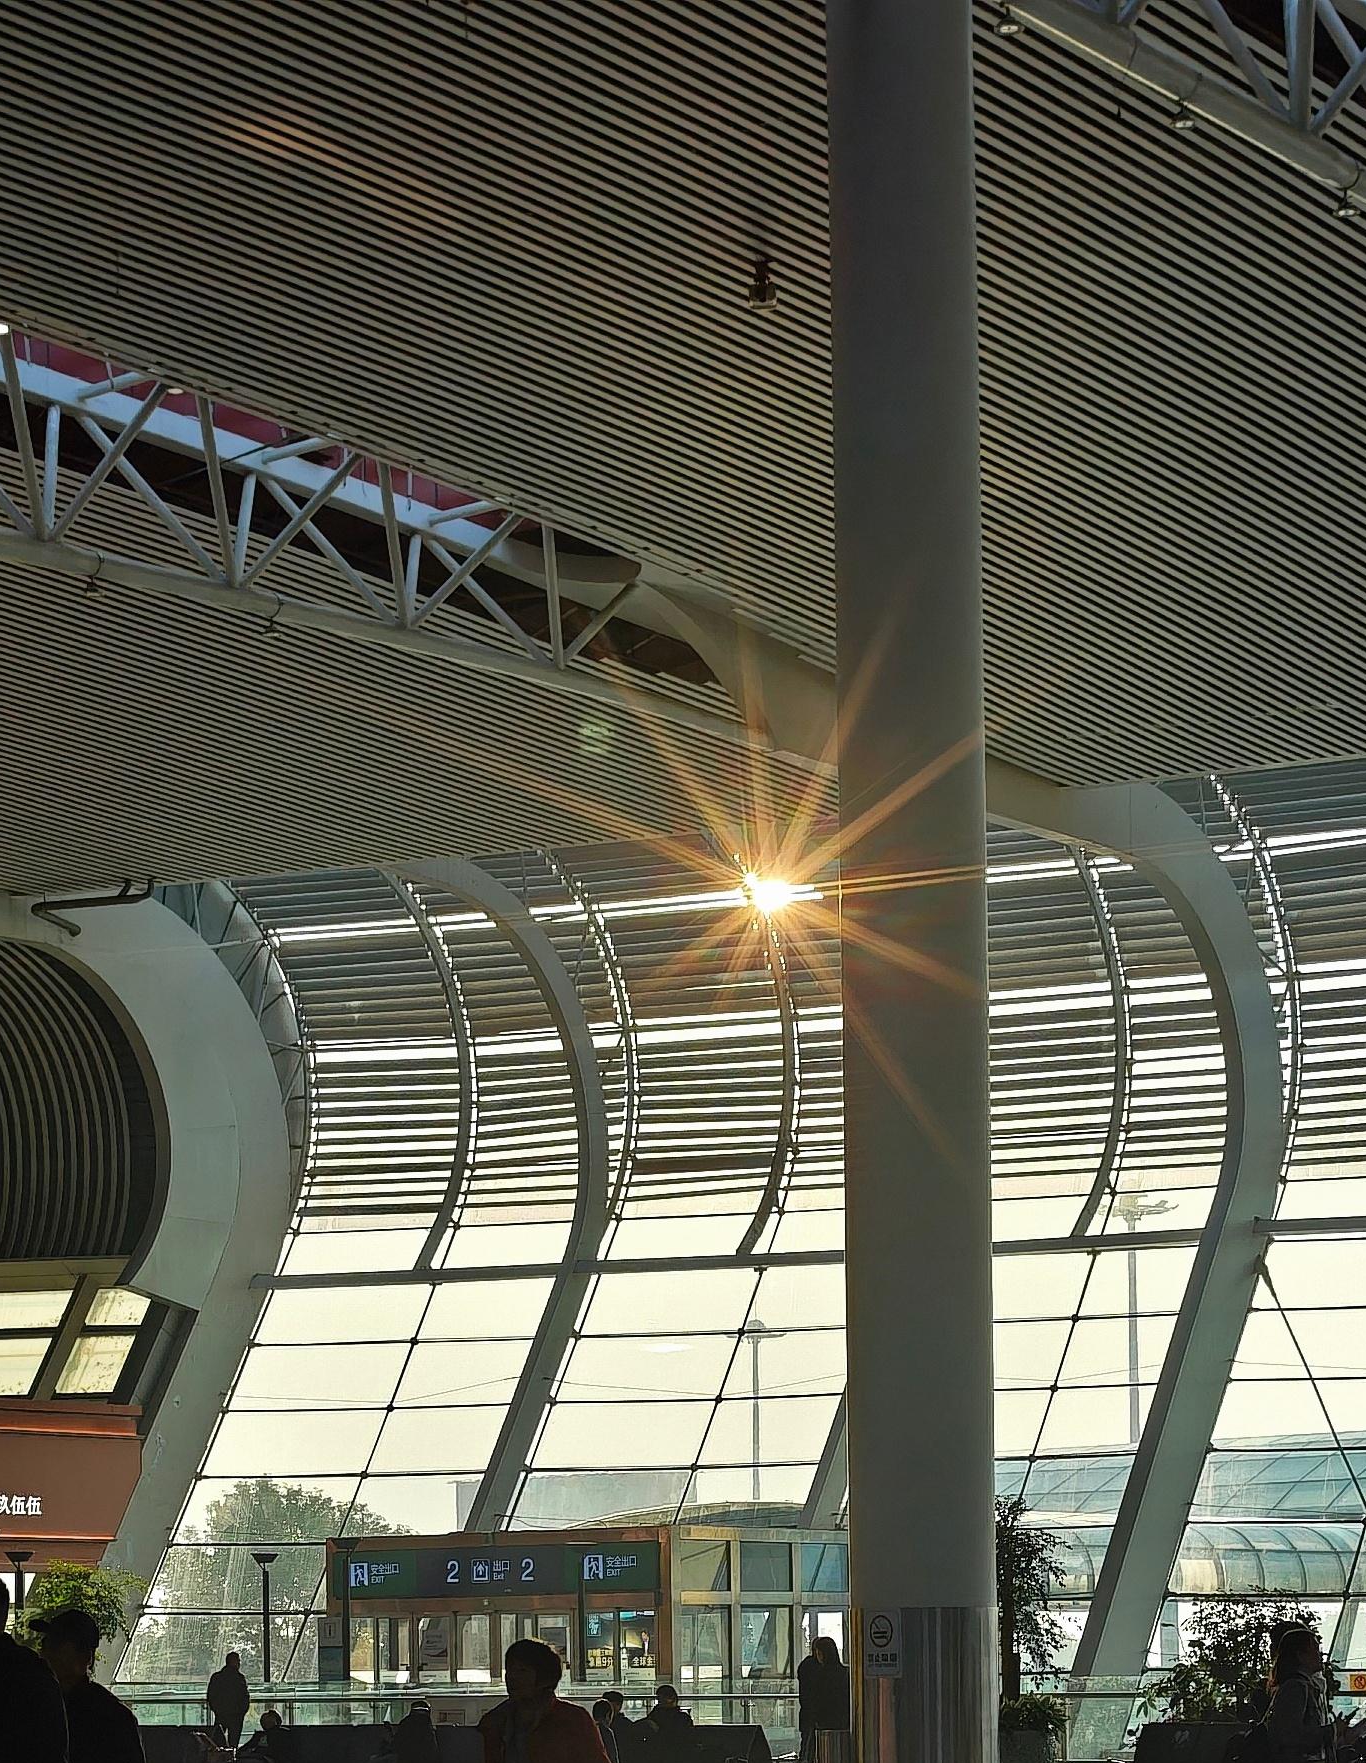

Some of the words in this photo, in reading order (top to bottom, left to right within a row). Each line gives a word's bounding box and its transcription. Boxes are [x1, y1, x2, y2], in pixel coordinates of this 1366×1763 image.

[493, 1560, 510, 1572] 出口
[605, 1555, 637, 1568] 安全出口
[370, 1563, 400, 1575] 安全出口
[446, 1560, 459, 1583] 2
[521, 1558, 535, 1581] 2
[606, 1568, 622, 1577] EXIT
[371, 1575, 384, 1584] EXIT
